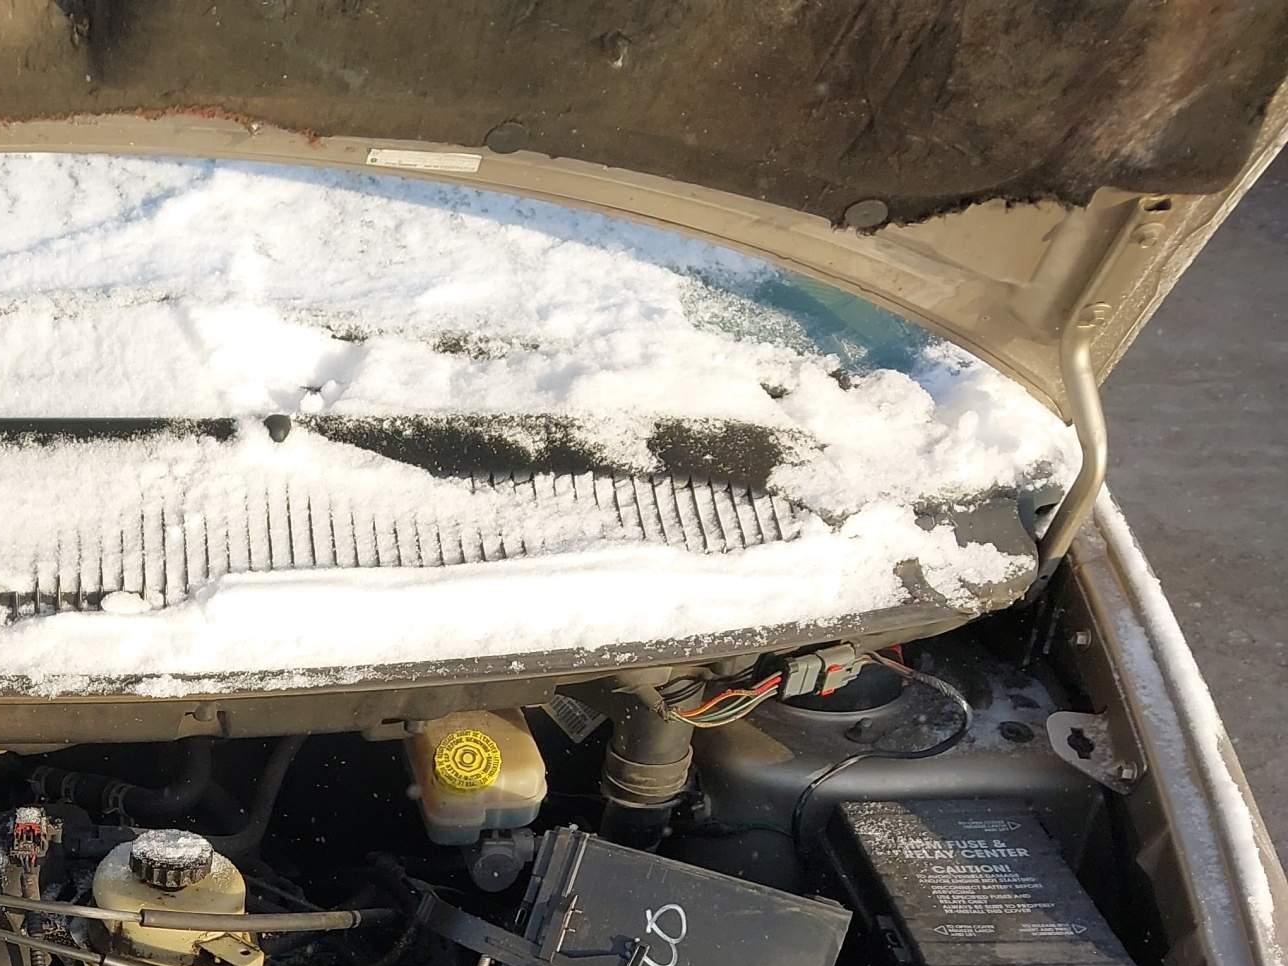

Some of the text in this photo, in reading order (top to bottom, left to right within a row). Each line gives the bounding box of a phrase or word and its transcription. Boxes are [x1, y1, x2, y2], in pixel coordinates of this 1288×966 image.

[946, 840, 989, 849] FUSE
[993, 840, 1007, 849] &
[903, 848, 1030, 859] RELAY CENTER
[931, 864, 1012, 874] CAUTION!
